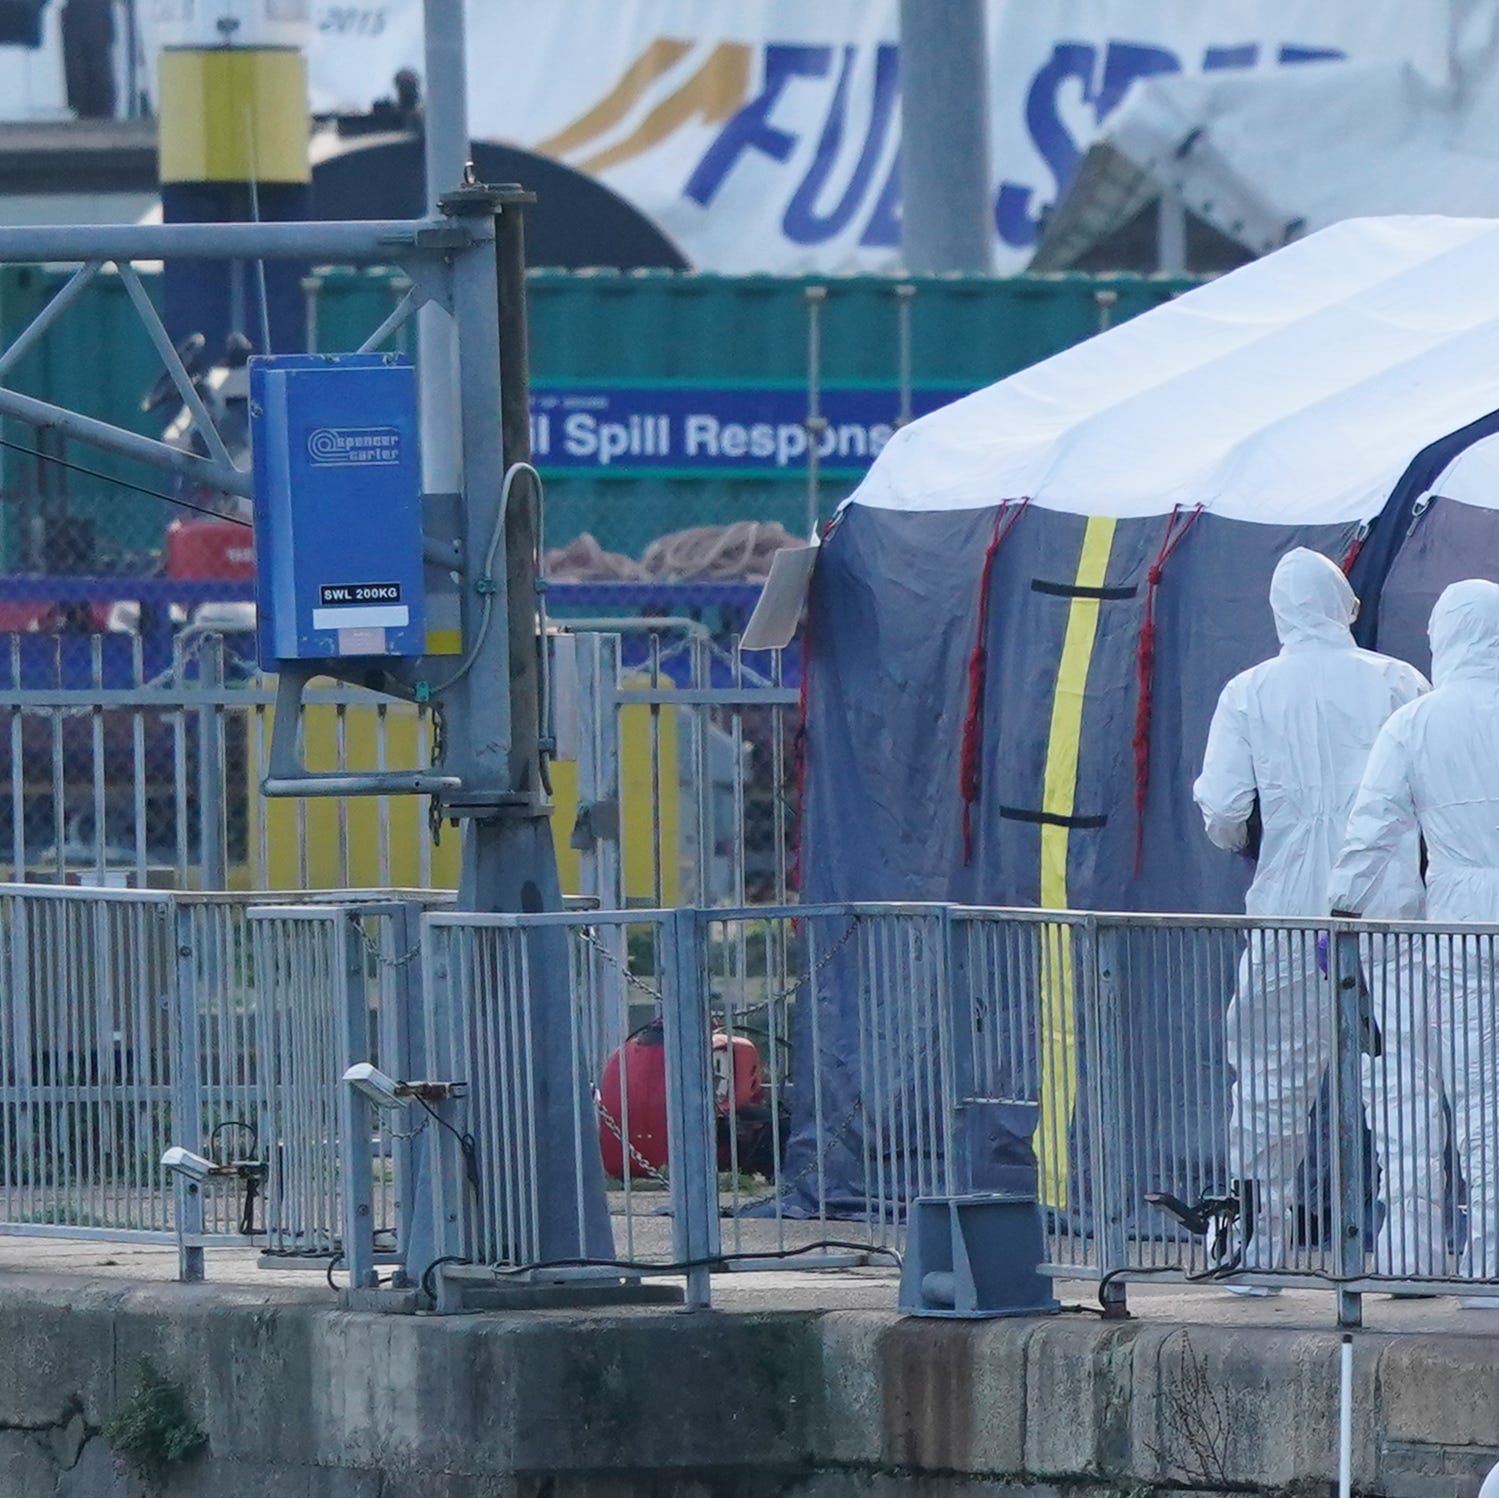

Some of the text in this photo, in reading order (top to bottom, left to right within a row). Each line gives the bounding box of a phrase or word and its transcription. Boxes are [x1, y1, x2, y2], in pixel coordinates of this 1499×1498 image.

[563, 411, 671, 466] Spill
[685, 412, 896, 467] Respons
[323, 586, 398, 601] SWL 200KG
